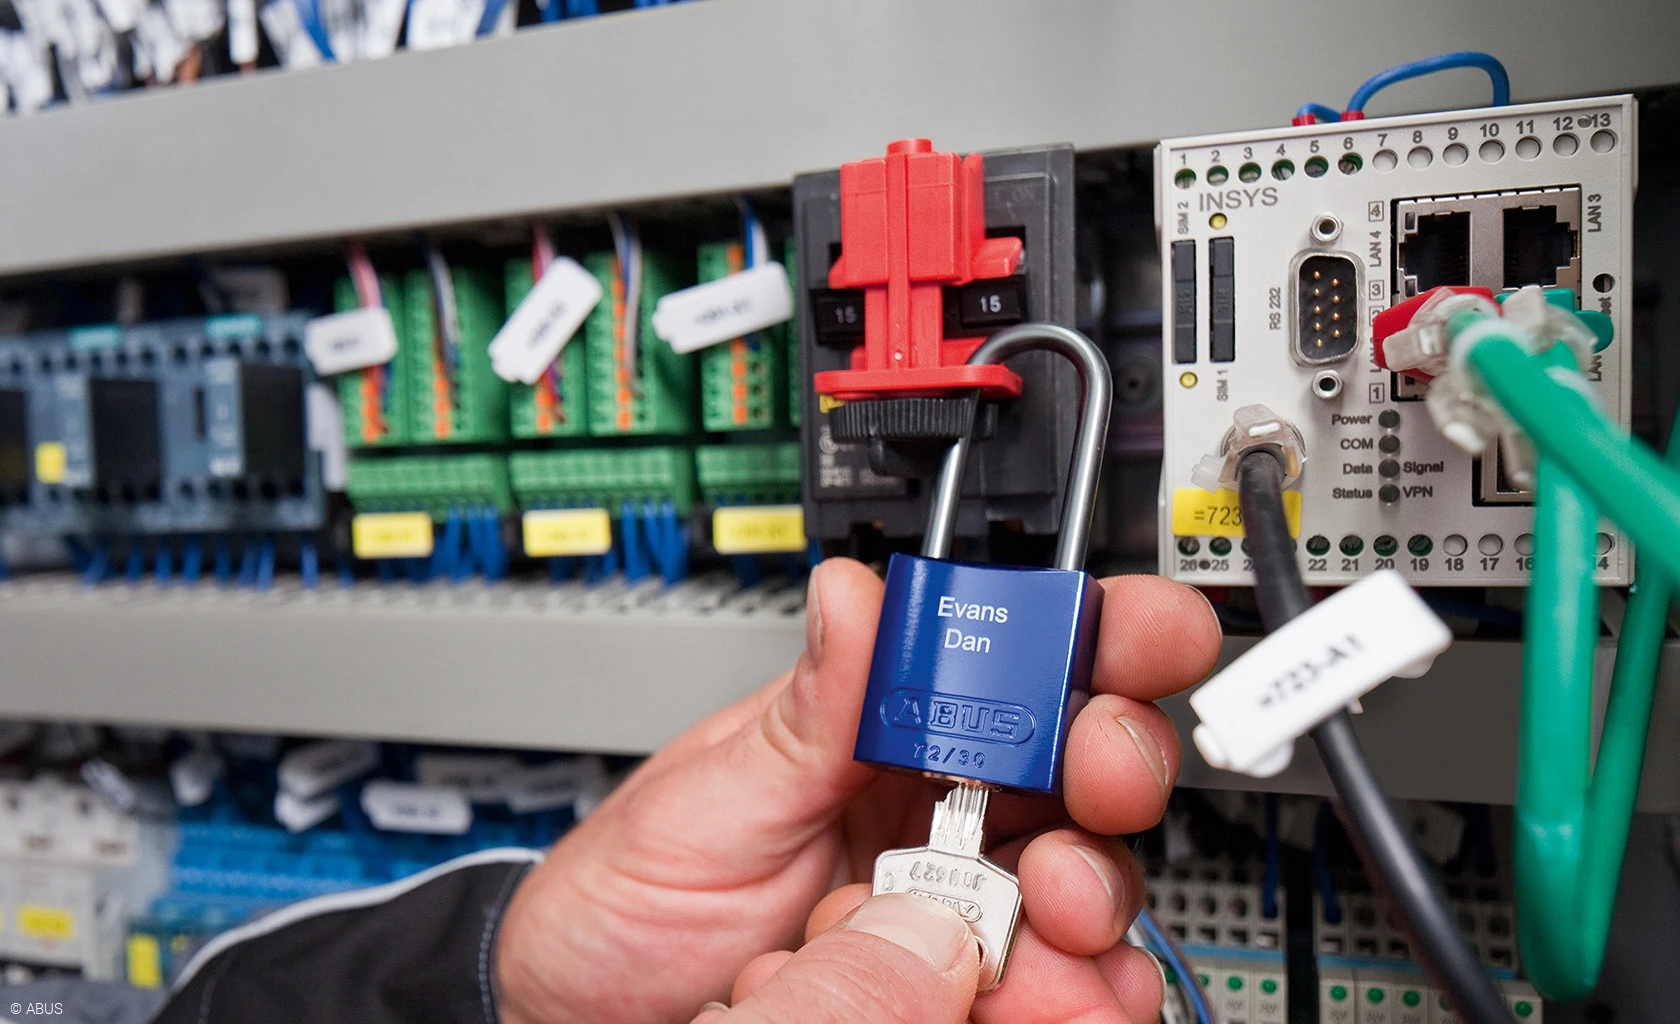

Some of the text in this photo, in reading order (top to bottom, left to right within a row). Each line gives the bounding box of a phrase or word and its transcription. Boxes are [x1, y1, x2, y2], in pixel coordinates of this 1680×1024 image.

[1180, 112, 1611, 165] 1 2 3 4 5 6 7 8 9 10 11 12 13
[1198, 186, 1279, 212] INSYS
[1177, 201, 1189, 235] SIM 2
[1370, 204, 1381, 217] 4
[1588, 193, 1602, 233] LAN 3
[1369, 229, 1382, 267] LAN 4
[1372, 283, 1381, 296] 3
[980, 294, 1002, 313] 15
[1269, 287, 1281, 330] RS 232
[1598, 296, 1612, 316] set
[1216, 380, 1229, 402] SIM
[1372, 386, 1380, 400] 1
[1331, 413, 1373, 426] Power
[1340, 438, 1374, 450] COM
[1342, 463, 1373, 475] Data
[1402, 461, 1444, 475] Signal
[1332, 487, 1373, 499] Status
[1402, 486, 1433, 498] VPN
[1179, 559, 1197, 572] 26
[1211, 558, 1230, 571] 25
[1308, 558, 1327, 572] 22
[1341, 558, 1359, 572] 21
[1375, 558, 1395, 571] 20
[1410, 557, 1430, 571] 19
[1444, 557, 1464, 571] 18
[1479, 556, 1499, 571] 17
[1597, 556, 1609, 571] 4
[937, 595, 1009, 624] Evans
[944, 627, 991, 654] Dan
[894, 697, 1020, 739] ABUS
